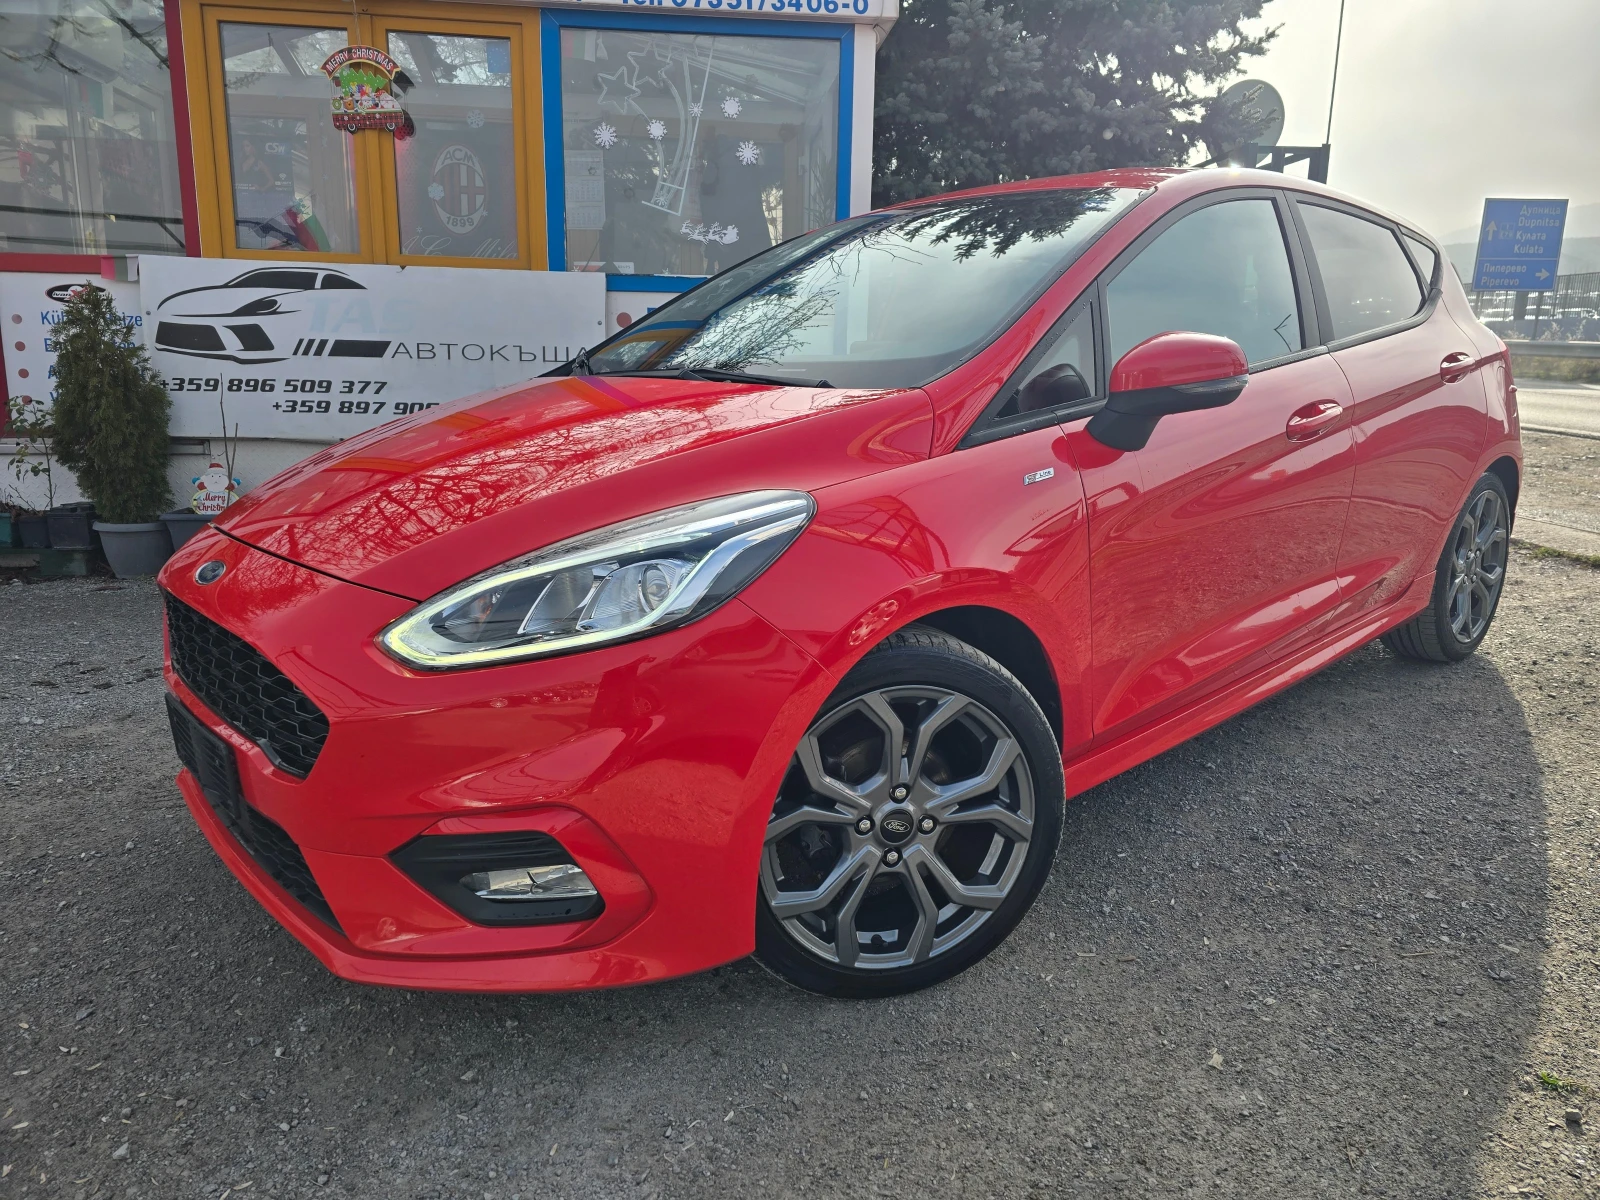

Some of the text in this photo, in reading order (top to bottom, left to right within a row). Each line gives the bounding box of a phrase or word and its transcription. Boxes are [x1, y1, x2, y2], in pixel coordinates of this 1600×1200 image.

[325, 48, 394, 72] MERRY CHRISTMAS
[441, 147, 476, 167] ACM
[1520, 204, 1560, 216] Дупница
[446, 215, 475, 228] 1899
[1518, 217, 1559, 228] Dupnitsa
[1515, 230, 1546, 242] Кулата
[1513, 244, 1544, 254] Kulata
[1483, 263, 1527, 274] Пиперево
[1480, 276, 1520, 287] Piperevo
[160, 377, 388, 395] +359 896 509 377
[272, 400, 332, 413] +359
[338, 401, 387, 415] 897
[203, 492, 226, 505] Merry
